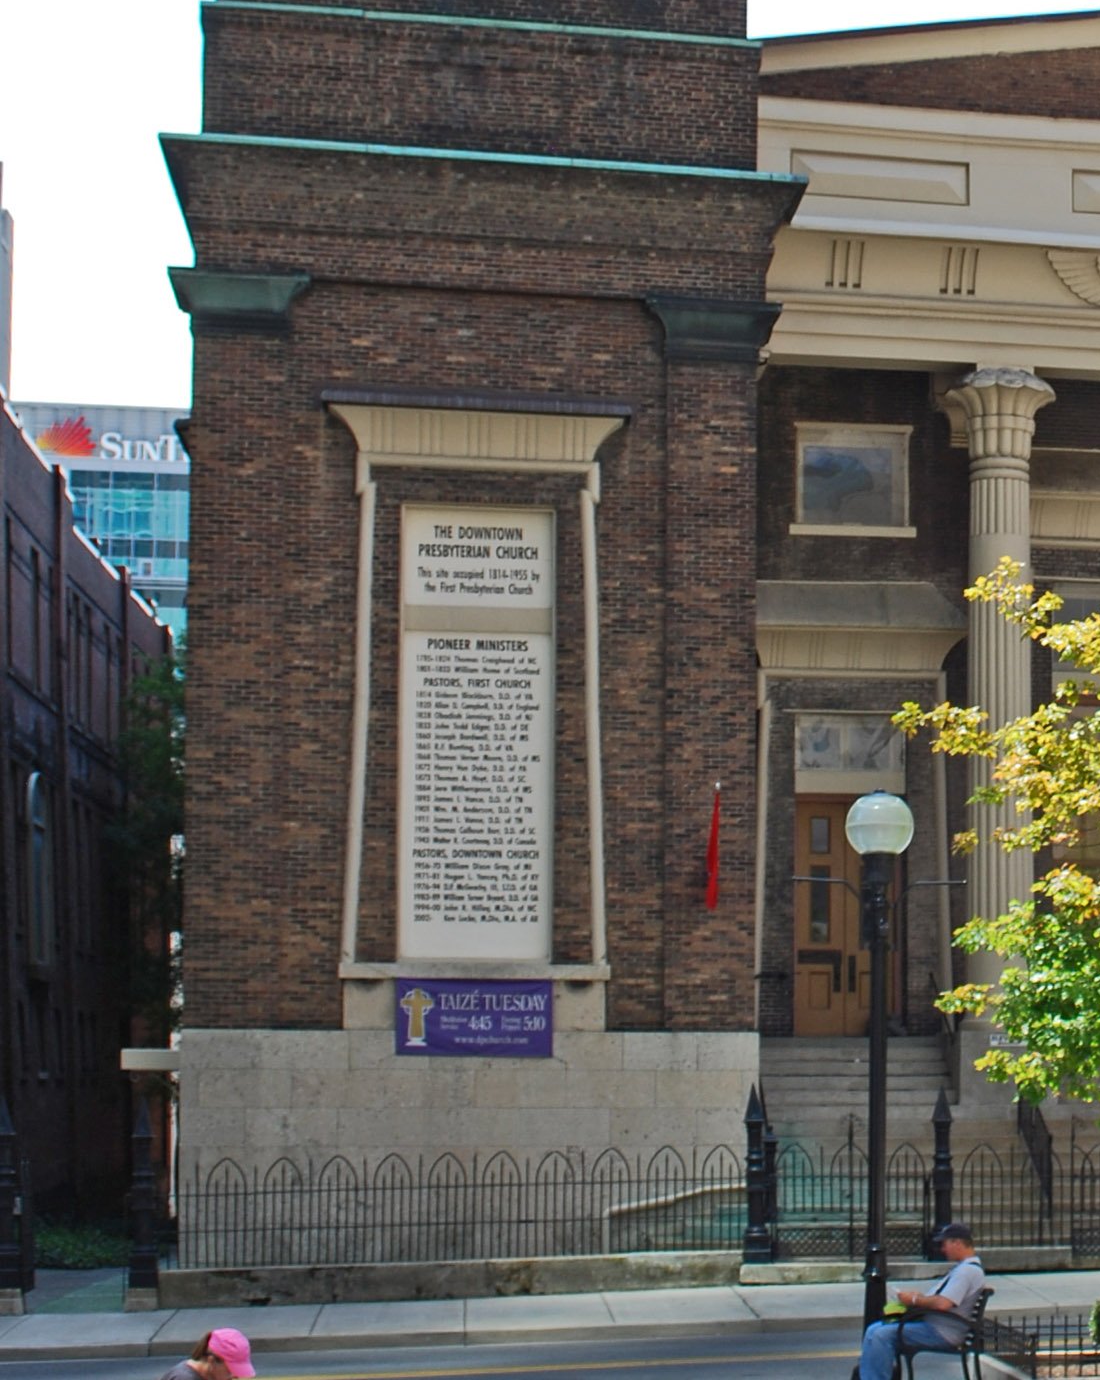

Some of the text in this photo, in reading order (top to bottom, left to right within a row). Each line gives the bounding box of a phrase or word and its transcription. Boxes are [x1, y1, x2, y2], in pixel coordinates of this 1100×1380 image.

[434, 525, 523, 541] THE DOWNTOWN
[418, 543, 538, 561] PRESBYTERIAN CHURCH
[418, 567, 540, 584] This site occupied 1814-1955 by
[424, 582, 533, 597] the First Presbyterian Church
[427, 638, 528, 652] PIONEER MINISTERS
[423, 677, 531, 689] PASTORS, FIRST CHURCH
[412, 848, 539, 860] PASTORS, DOWNTOWN CHURCH
[438, 989, 548, 1012] TAIZÉ TUESDAY
